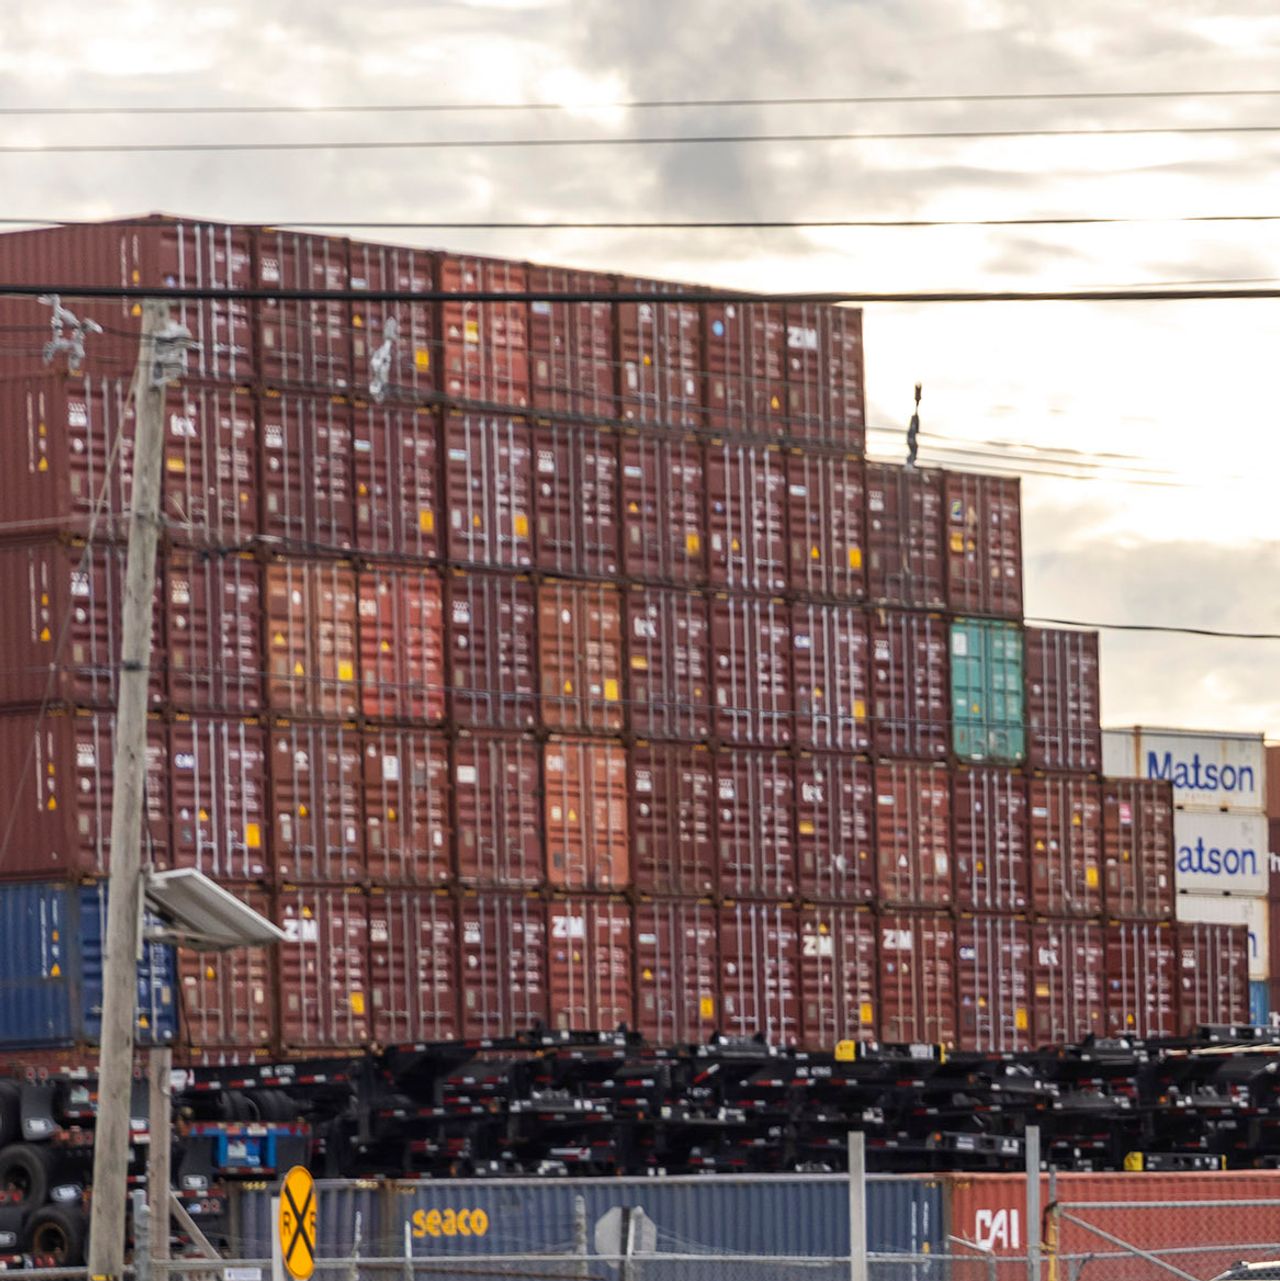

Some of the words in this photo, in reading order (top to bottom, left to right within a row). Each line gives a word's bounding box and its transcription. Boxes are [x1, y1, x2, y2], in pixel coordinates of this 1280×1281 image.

[1147, 751, 1255, 792] Matson
[1177, 836, 1258, 876] atson
[411, 1207, 489, 1239] seaco
[975, 1208, 1020, 1251] CAI
